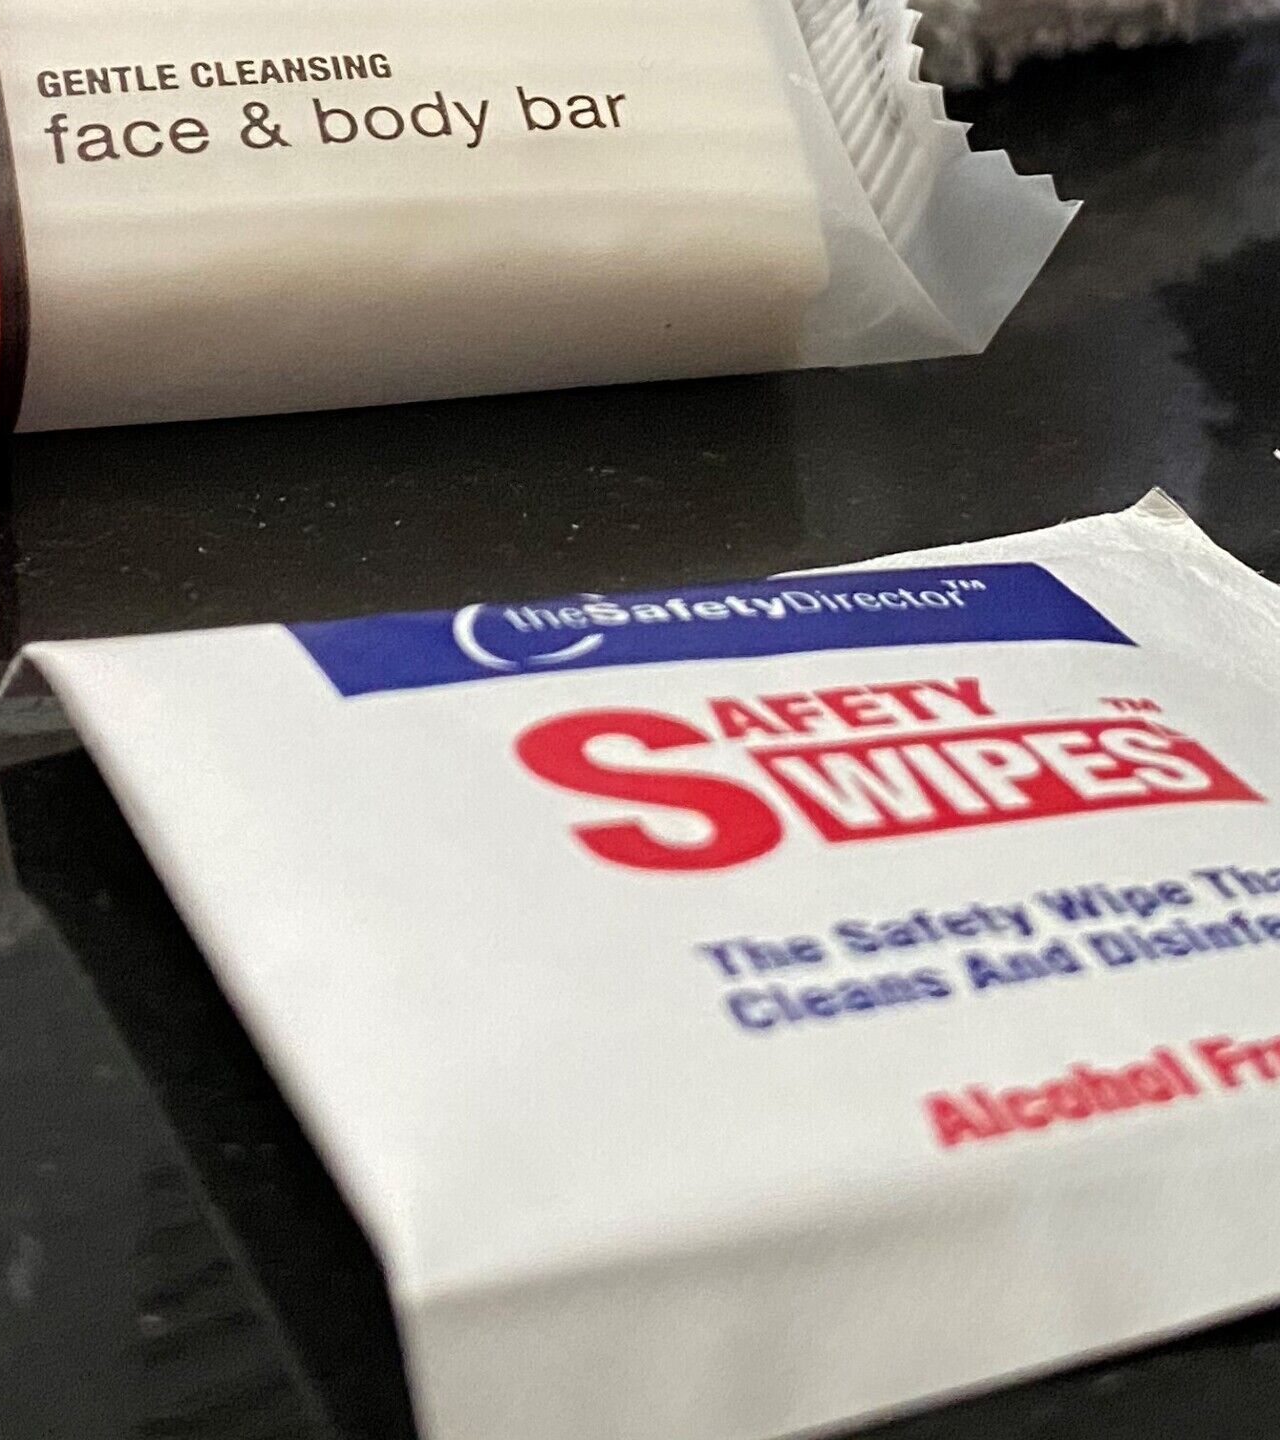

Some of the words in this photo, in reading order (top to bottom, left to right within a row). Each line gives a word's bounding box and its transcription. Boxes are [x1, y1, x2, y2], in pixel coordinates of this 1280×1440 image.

[36, 62, 180, 99] GENTLE
[190, 53, 393, 88] CLEANSING
[43, 112, 210, 165] face
[239, 100, 293, 150] &
[312, 89, 490, 149] body
[516, 85, 627, 132] bar
[512, 675, 997, 874] SAFETY
[770, 726, 1213, 832] WIPES
[696, 933, 825, 977] The
[832, 900, 1036, 956] Safety
[1037, 875, 1194, 923] Wipe
[725, 967, 952, 1031] Cleans
[963, 939, 1083, 990] And
[922, 1046, 1201, 1149] Alcohol
